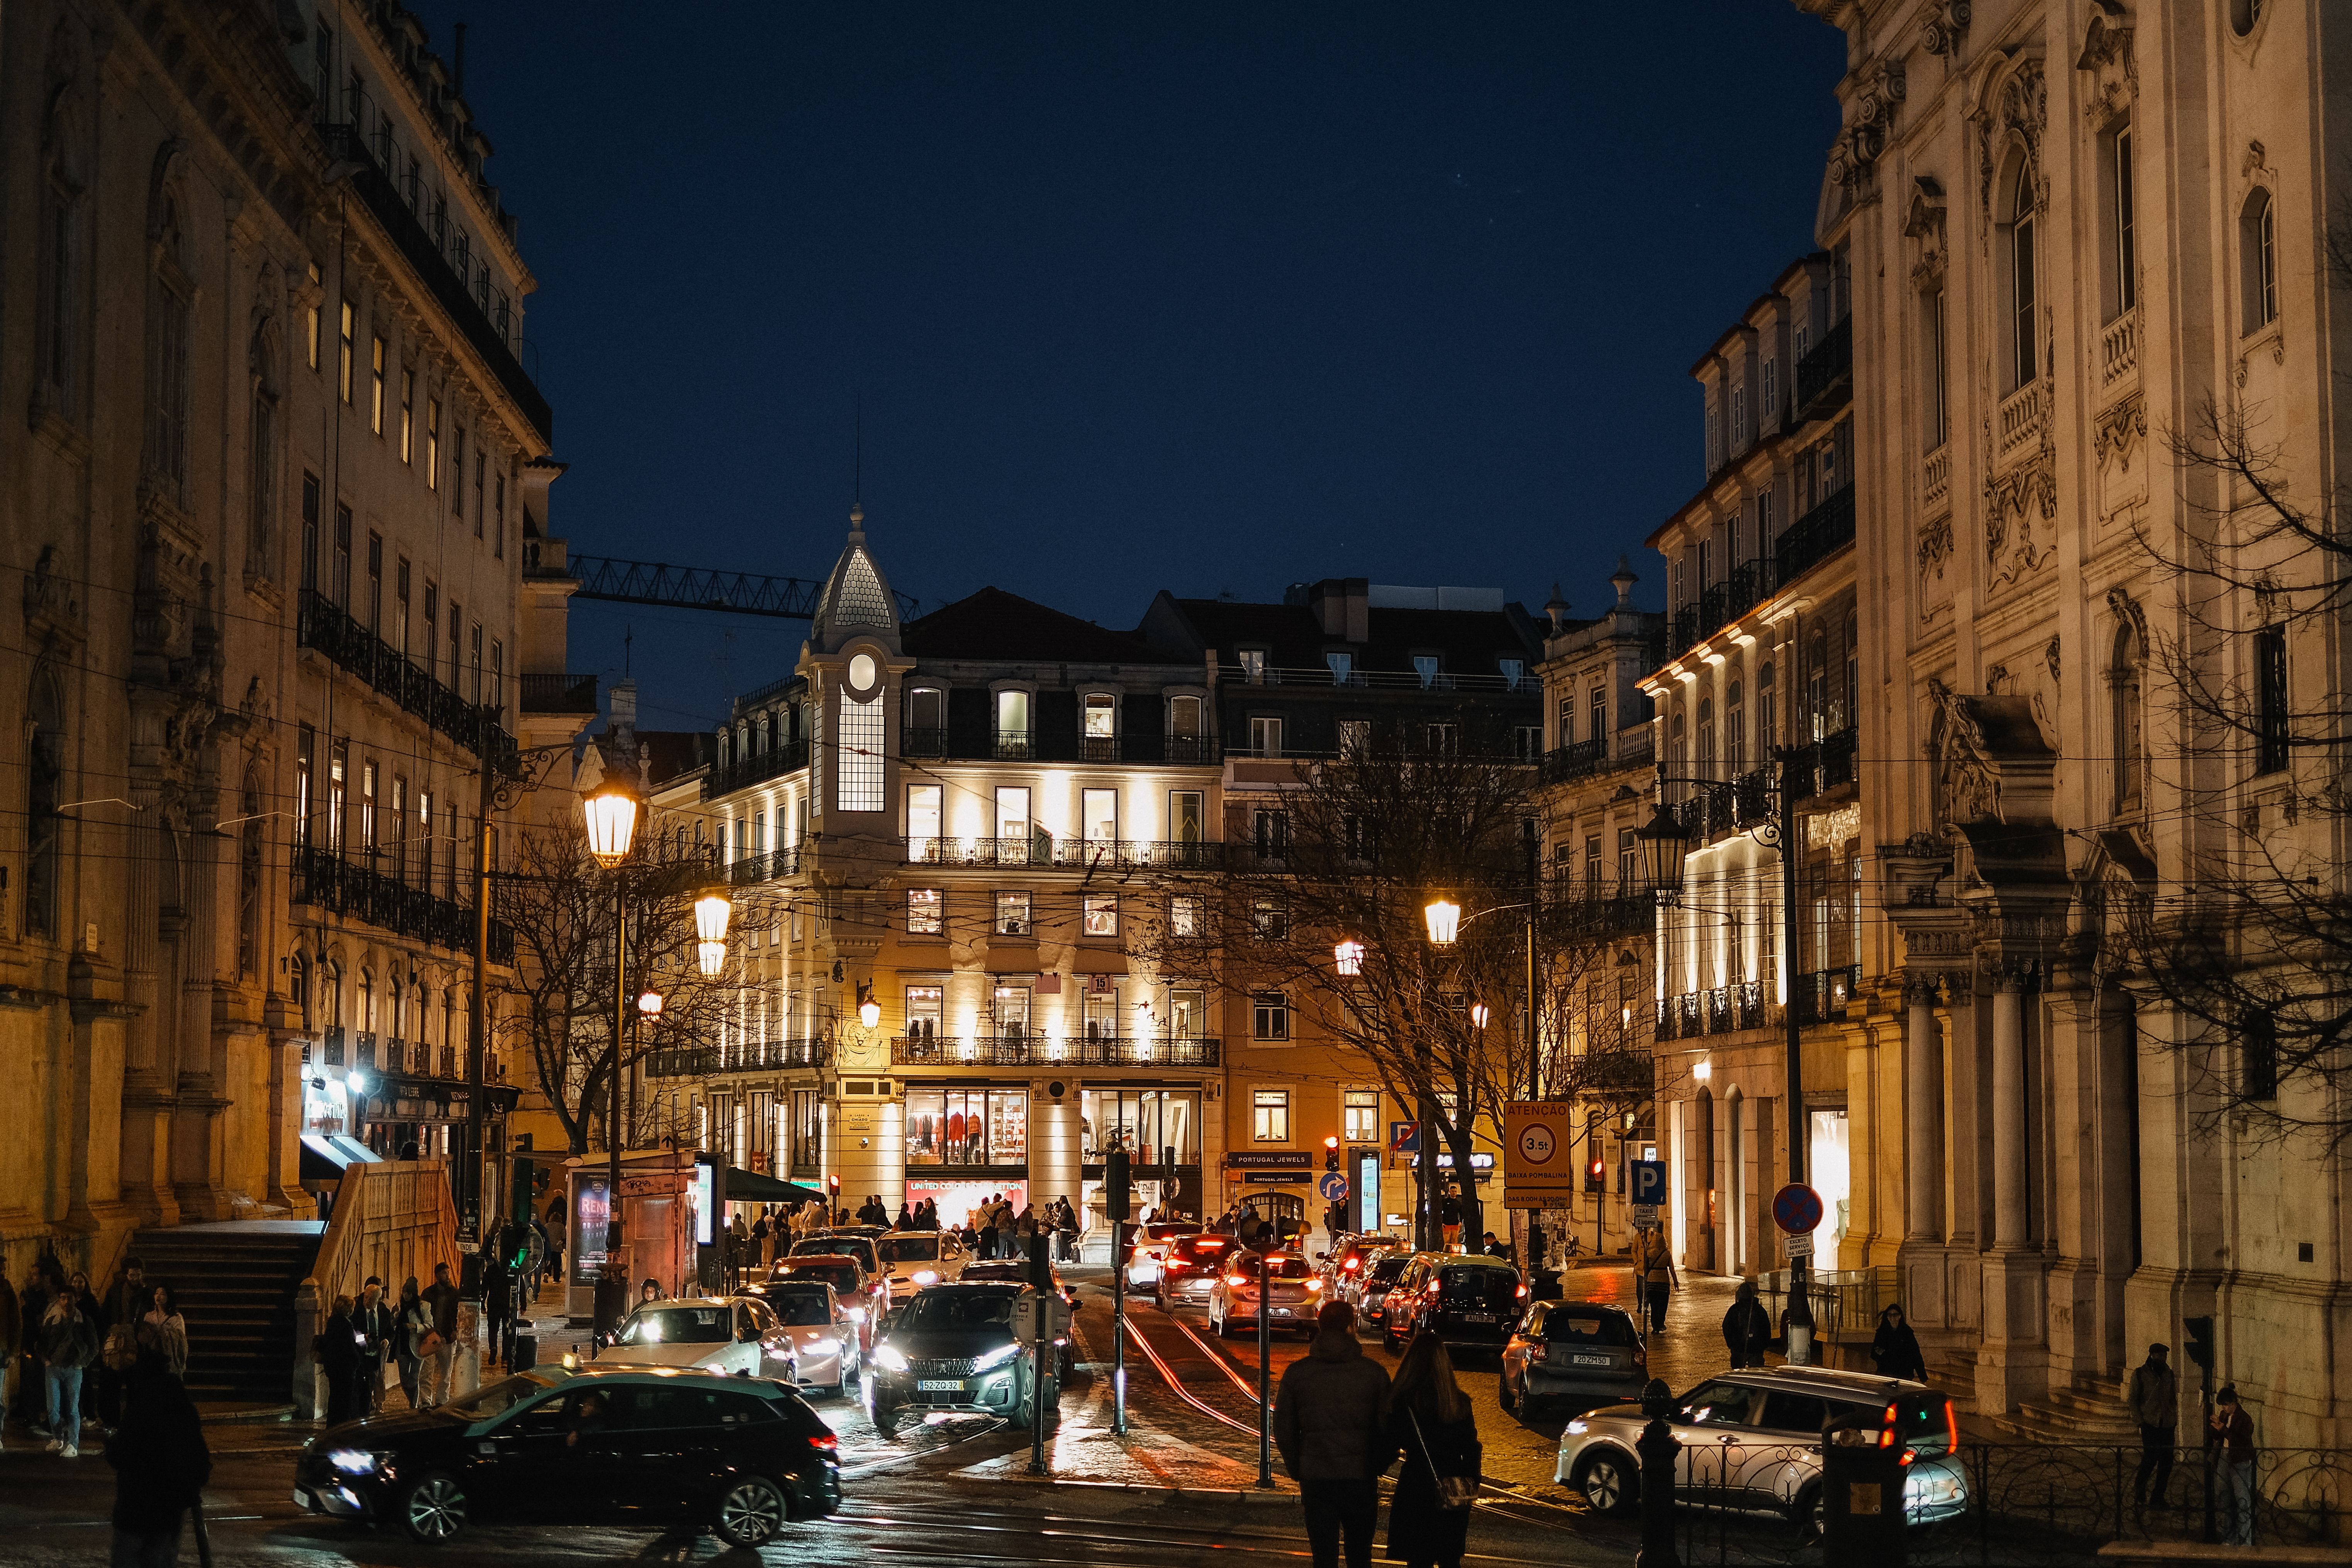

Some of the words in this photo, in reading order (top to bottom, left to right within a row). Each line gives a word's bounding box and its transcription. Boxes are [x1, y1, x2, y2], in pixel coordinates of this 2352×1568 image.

[1095, 978, 1106, 987] 15
[1508, 1104, 1567, 1118] ATENÇÃO
[1639, 1167, 1658, 1197] P
[582, 1198, 609, 1214] RENT
